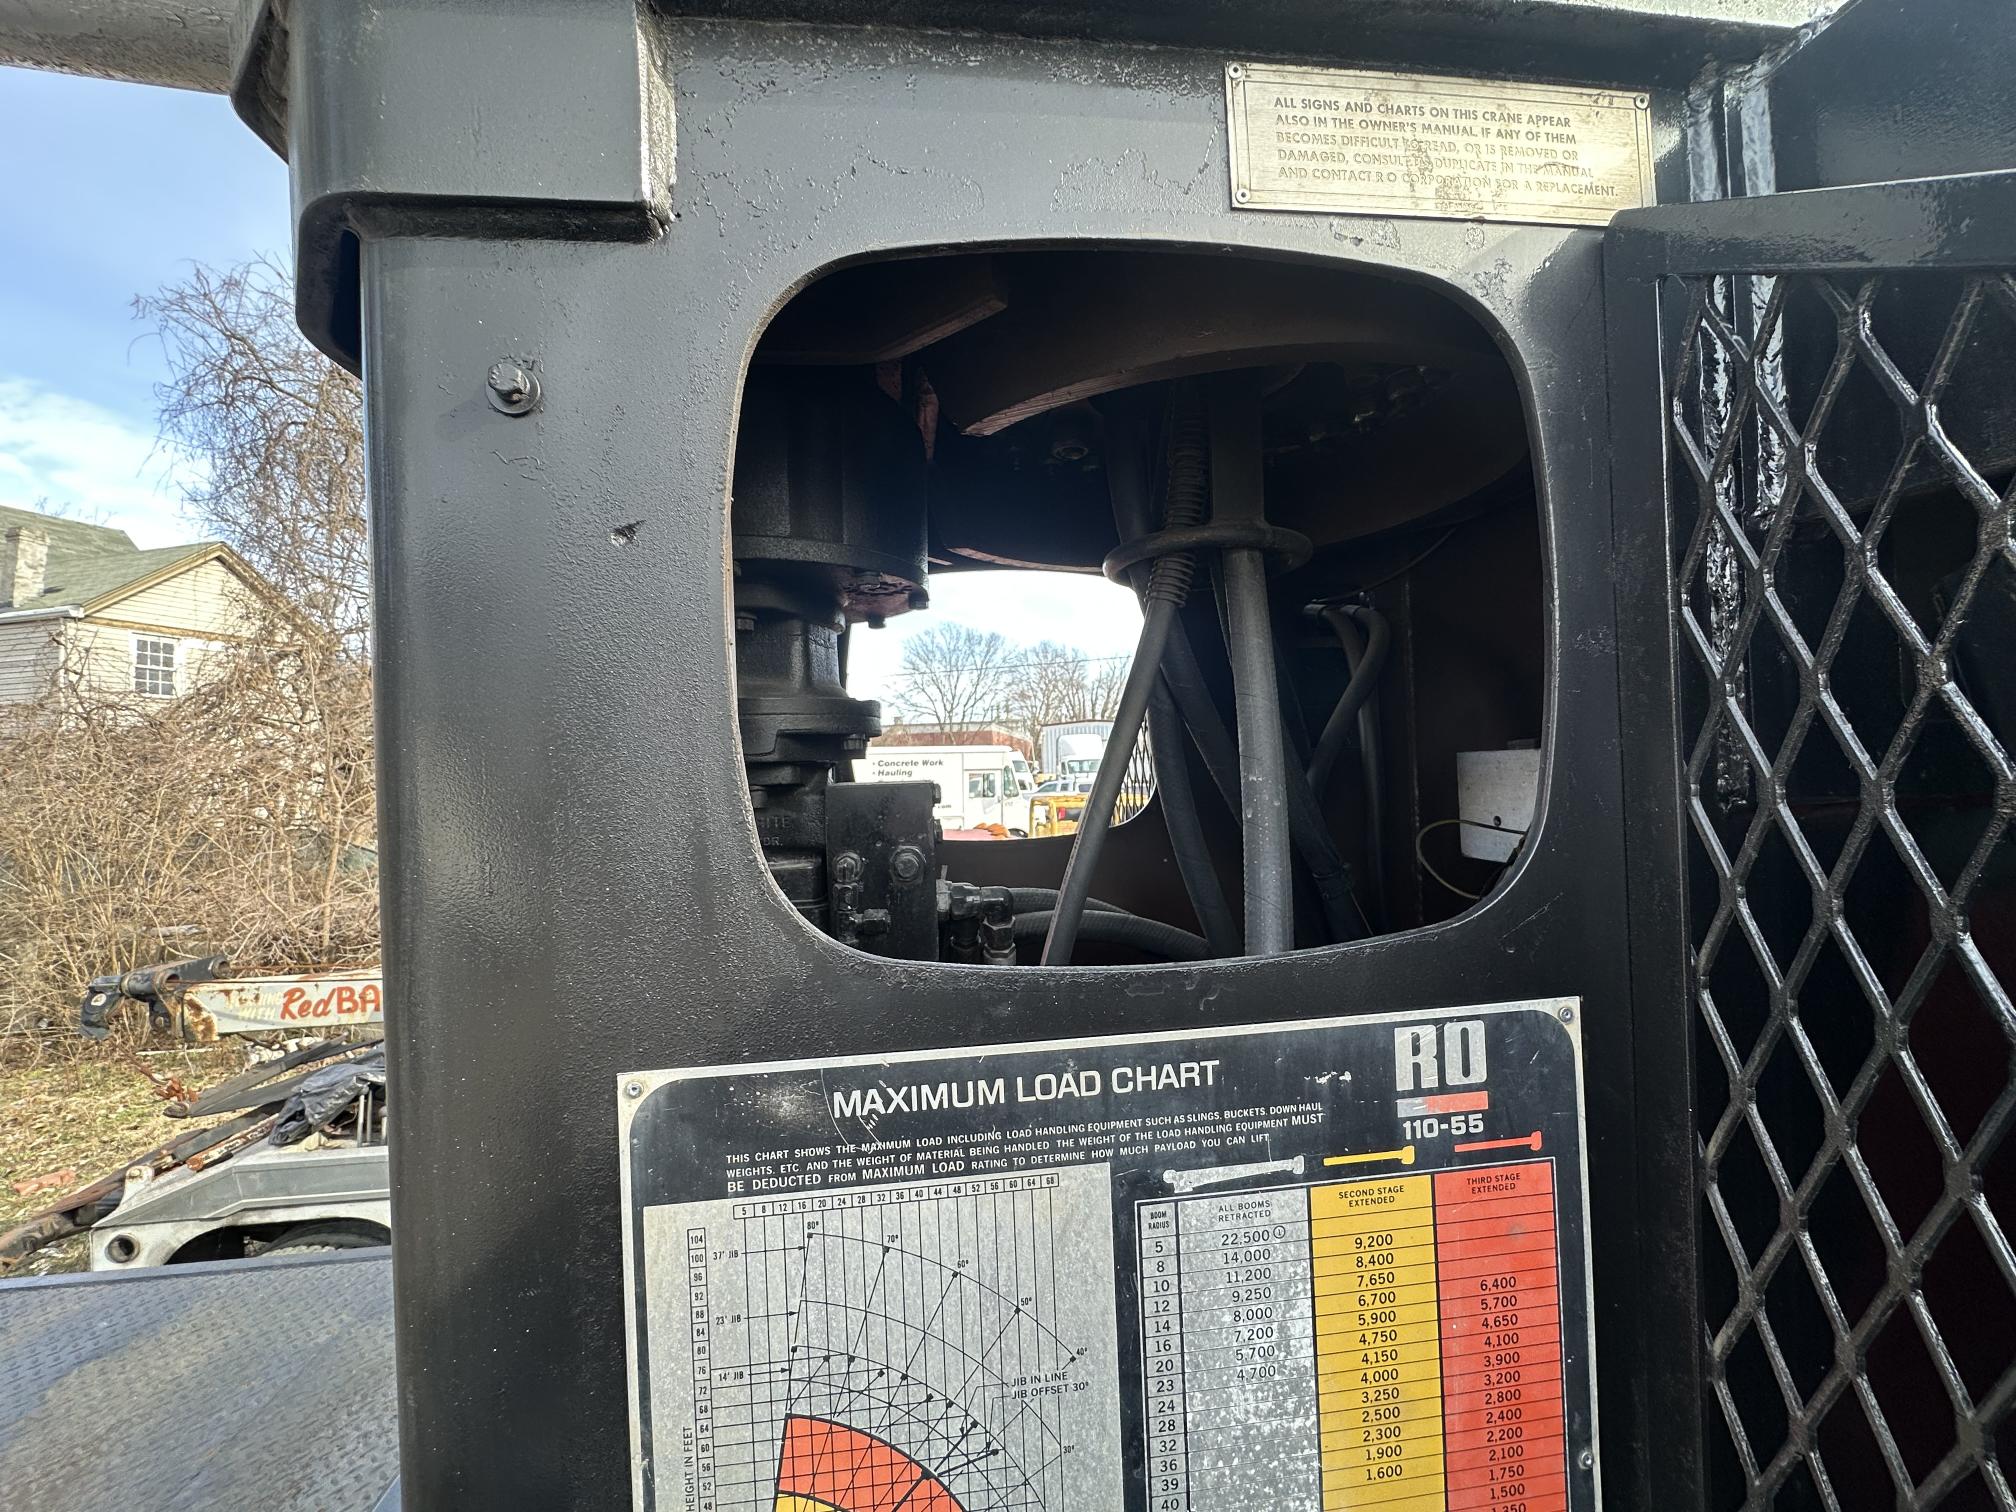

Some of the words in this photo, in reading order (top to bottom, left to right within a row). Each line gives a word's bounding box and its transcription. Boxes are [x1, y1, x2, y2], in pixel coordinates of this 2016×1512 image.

[1274, 97, 1296, 108] ALL
[1301, 99, 1339, 111] SIGNS
[1345, 101, 1372, 113] AND
[1377, 103, 1425, 116] CHARTS
[1430, 107, 1449, 119] ON
[1453, 108, 1478, 120] THIS
[1483, 111, 1522, 123] CRANE
[1527, 114, 1570, 127] APPEAR
[1276, 114, 1309, 126] ALSO
[1314, 117, 1327, 127] IN
[1332, 118, 1354, 129] THE
[1359, 120, 1416, 132] OWNER'S
[1482, 128, 1490, 138] IF
[1496, 129, 1520, 140] ANY
[1525, 131, 1541, 141] OF
[1545, 132, 1576, 144] THEM
[1276, 132, 1336, 145] BECOMES
[1341, 135, 1398, 149] DIFFICULT
[1501, 145, 1558, 160] REMOVED
[1563, 149, 1578, 160] OR
[1278, 150, 1348, 165] DAMAGED,
[1436, 158, 1496, 173] DUPLICATE
[1502, 161, 1513, 173] IN
[1519, 163, 1538, 174] THE
[1543, 163, 1594, 178] MANUAL
[1279, 167, 1307, 178] AND
[1312, 169, 1371, 182] CONTACT
[1524, 181, 1532, 191] A
[1394, 1020, 1487, 1091] RO
[833, 1078, 1005, 1118] MAXIMUM
[1016, 1070, 1101, 1102] LOAD
[1111, 1060, 1220, 1094] CHART
[727, 1154, 749, 1164] THIS
[755, 1150, 788, 1161] CHART
[795, 1147, 831, 1157] SHOWS
[836, 1145, 856, 1155] THE
[862, 1140, 911, 1152] MAXIMUM
[917, 1137, 943, 1147] LOAD
[947, 1132, 1001, 1144] INCLUDING
[1007, 1129, 1031, 1139] LOAD
[1035, 1124, 1085, 1136] HANDLING
[1088, 1119, 1142, 1132] EQUIPMENT
[1146, 1116, 1171, 1126] SUCH
[1174, 1115, 1185, 1124] AS
[1270, 1105, 1297, 1115] DOWN
[1299, 1102, 1323, 1112] HAUL
[1403, 1113, 1484, 1139] 110-55
[807, 1160, 828, 1170] AND
[832, 1158, 852, 1168] THE
[857, 1154, 895, 1166] WEIGHT
[900, 1152, 913, 1162] OF
[916, 1149, 965, 1161] MATERIAL
[970, 1146, 999, 1157] BEING
[1004, 1142, 1049, 1153] HANDLED
[1057, 1139, 1074, 1148] THE
[1079, 1135, 1115, 1146] WEIGHT
[1120, 1134, 1131, 1143] OF
[1135, 1131, 1153, 1141] THE
[1157, 1129, 1181, 1139] LOAD
[1185, 1124, 1232, 1136] HANDLING
[1236, 1119, 1287, 1132] EQUIPMENT
[1292, 1113, 1323, 1125] MUST
[728, 1181, 744, 1193] BE
[752, 1174, 821, 1190] DEDUCTED
[829, 1173, 856, 1184] FROM
[863, 1164, 924, 1180] MAXIMUM
[932, 1161, 964, 1173] LOAD
[972, 1159, 1007, 1170] RATING
[1013, 1157, 1025, 1166] TO
[1031, 1152, 1085, 1164] DETERMINE
[1092, 1149, 1113, 1158] HOW
[1120, 1146, 1148, 1156] MUCH
[1155, 1141, 1195, 1152] PAYLOAD
[1202, 1139, 1220, 1148] YOU
[1227, 1136, 1245, 1146] CAN
[1467, 1176, 1492, 1185] THIRD
[1494, 1173, 1521, 1183] STAGE
[1339, 1188, 1375, 1199] SECOND
[1378, 1185, 1404, 1195] STAGE
[1472, 1182, 1516, 1194] EXTENDED
[1238, 1200, 1270, 1210] BOOMS
[1349, 1196, 1395, 1207] EXTENDED
[1151, 1211, 1166, 1219] BOOM
[1219, 1210, 1271, 1222] RETRACTED
[1148, 1221, 1169, 1229] RADIUS
[691, 1235, 703, 1244] 104
[1222, 1230, 1270, 1246] 22,500
[1355, 1234, 1393, 1250] 9,200
[728, 1250, 738, 1259] JIB
[1155, 1241, 1163, 1253] 5
[691, 1254, 703, 1263] 100
[1223, 1249, 1271, 1265] 14,000
[1356, 1253, 1394, 1268] 8,400
[1157, 1261, 1164, 1272] 8
[1226, 1268, 1271, 1284] 11,200
[1357, 1272, 1395, 1288] 7,650
[1153, 1280, 1169, 1292] 10
[1480, 1276, 1517, 1292] 6,400
[1232, 1287, 1271, 1302] 9,250
[1358, 1291, 1396, 1307] 6,700
[1154, 1300, 1169, 1313] 12
[1481, 1295, 1517, 1311] 5,700
[1234, 1307, 1272, 1323] 8,000
[1358, 1311, 1396, 1326] 5,900
[1482, 1314, 1518, 1329] 4,650
[1155, 1320, 1170, 1332] 14
[1359, 1330, 1397, 1345] 4,750
[1485, 1333, 1519, 1347] 4,100
[1155, 1340, 1171, 1352] 16
[1156, 1360, 1173, 1372] 20
[1012, 1377, 1026, 1387] JIB
[1031, 1375, 1041, 1384] IN
[1045, 1372, 1068, 1382] LINE
[1361, 1369, 1398, 1385] 4,000
[1012, 1390, 1026, 1400] JIB
[1031, 1384, 1069, 1397] OFFSET
[1157, 1380, 1174, 1392] 23
[1362, 1387, 1400, 1404] 3,250
[1485, 1389, 1521, 1405] 2,800
[1158, 1400, 1175, 1412] 24
[1362, 1406, 1400, 1423] 2,500
[1486, 1408, 1522, 1424] 2,400
[1158, 1420, 1176, 1432] 28
[683, 1427, 692, 1452] FEET
[1487, 1427, 1522, 1442] 2,200
[1159, 1440, 1176, 1452] 32
[684, 1456, 692, 1466] IN
[1160, 1459, 1177, 1472] 36
[685, 1470, 695, 1512] HEIGHT
[1162, 1478, 1178, 1491] 39
[1490, 1484, 1525, 1500] 1,500
[1162, 1498, 1179, 1511] 40
